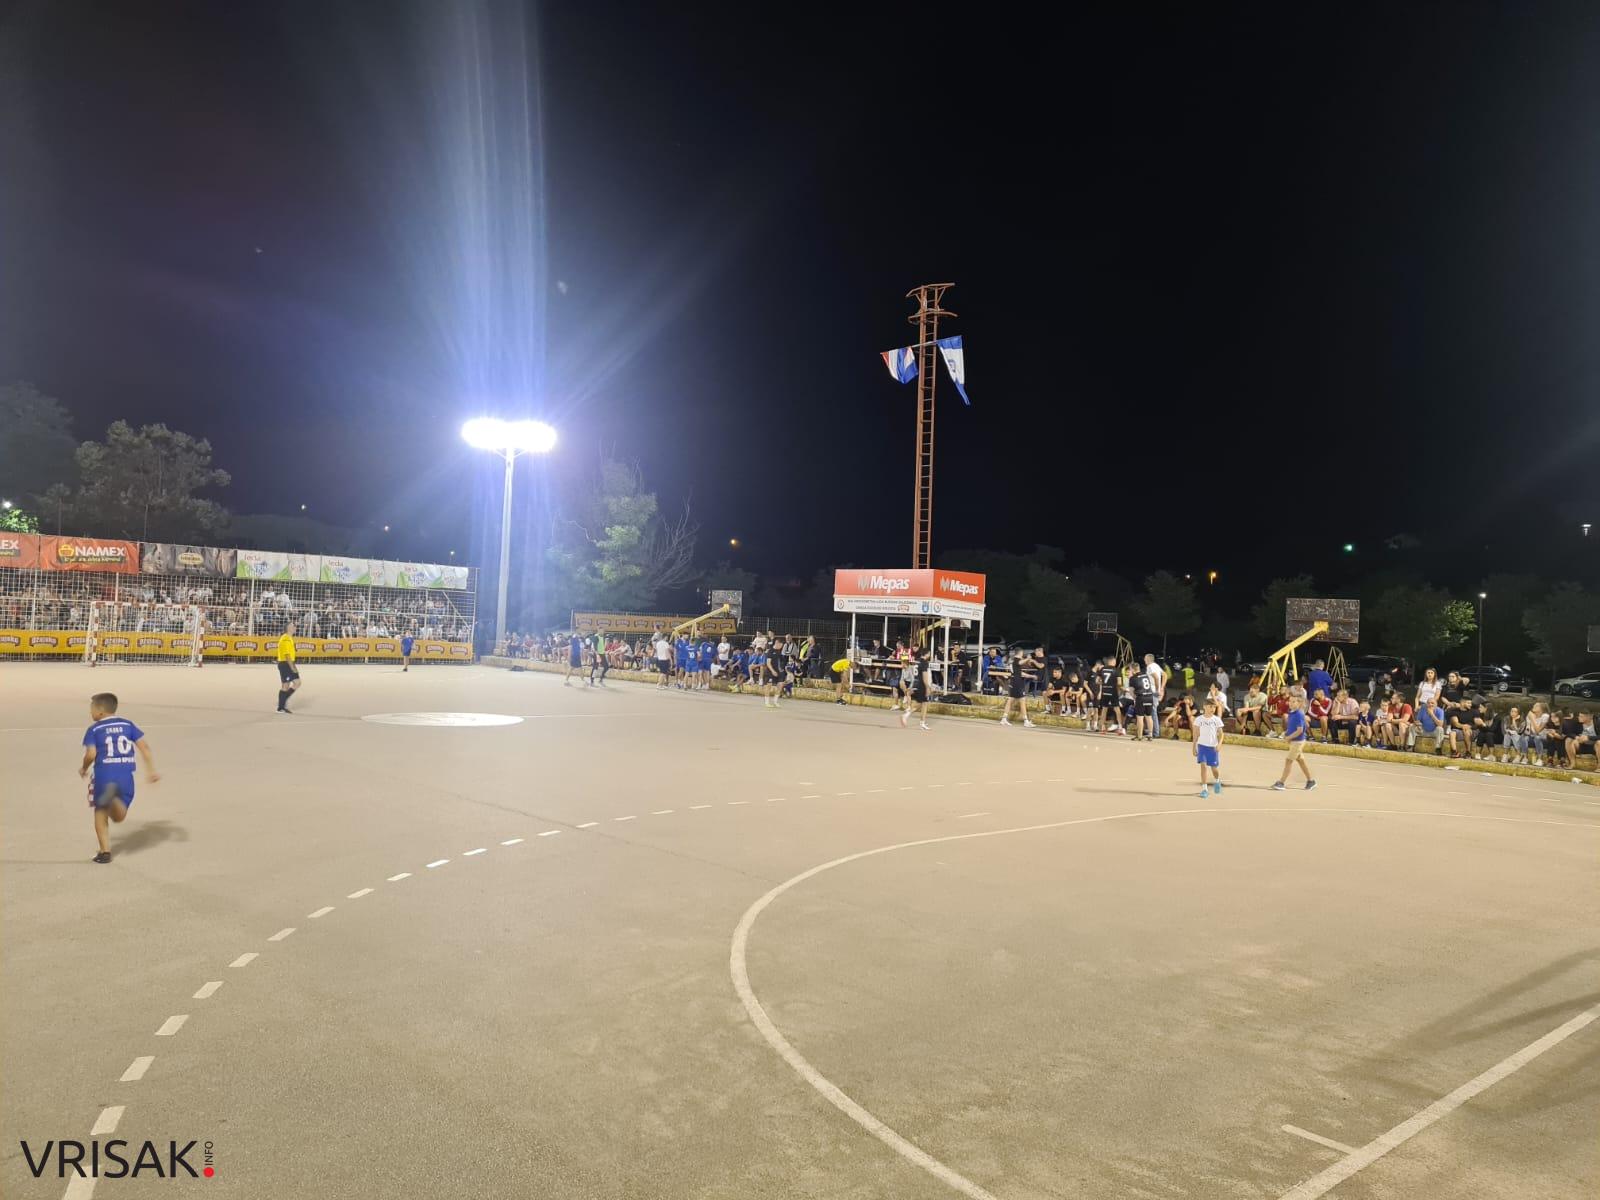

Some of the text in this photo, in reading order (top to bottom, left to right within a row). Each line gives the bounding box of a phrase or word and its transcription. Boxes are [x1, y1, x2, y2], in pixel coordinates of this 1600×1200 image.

[75, 546, 126, 557] NAMEX
[870, 576, 910, 593] Mepas
[949, 579, 979, 596] Mepas
[1103, 672, 1112, 685] 7
[1142, 677, 1150, 690] 8
[105, 735, 133, 757] 10
